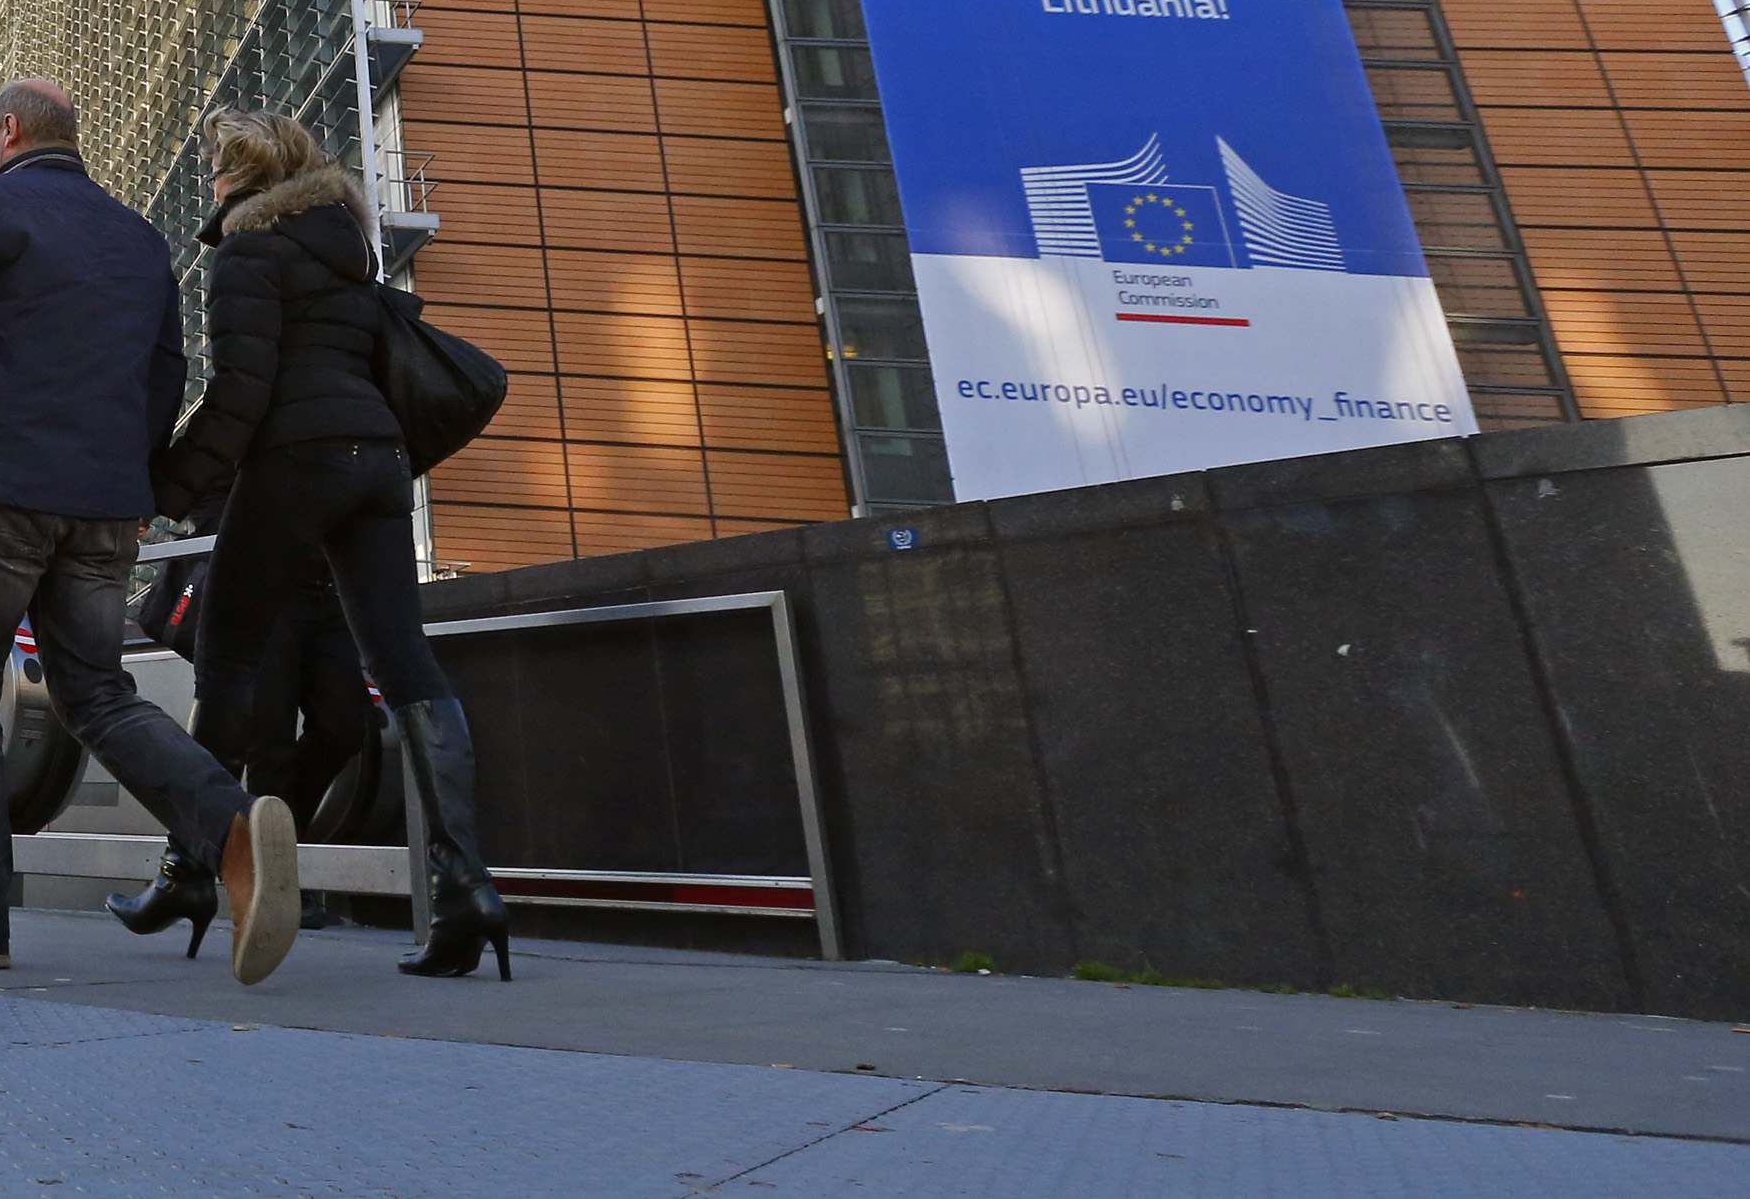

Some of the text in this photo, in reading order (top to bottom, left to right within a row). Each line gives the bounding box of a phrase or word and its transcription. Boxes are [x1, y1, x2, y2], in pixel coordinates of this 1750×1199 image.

[1112, 269, 1193, 288] European
[1118, 290, 1220, 310] Commission
[957, 377, 1453, 424] ec.europa.eu/economy_finance
